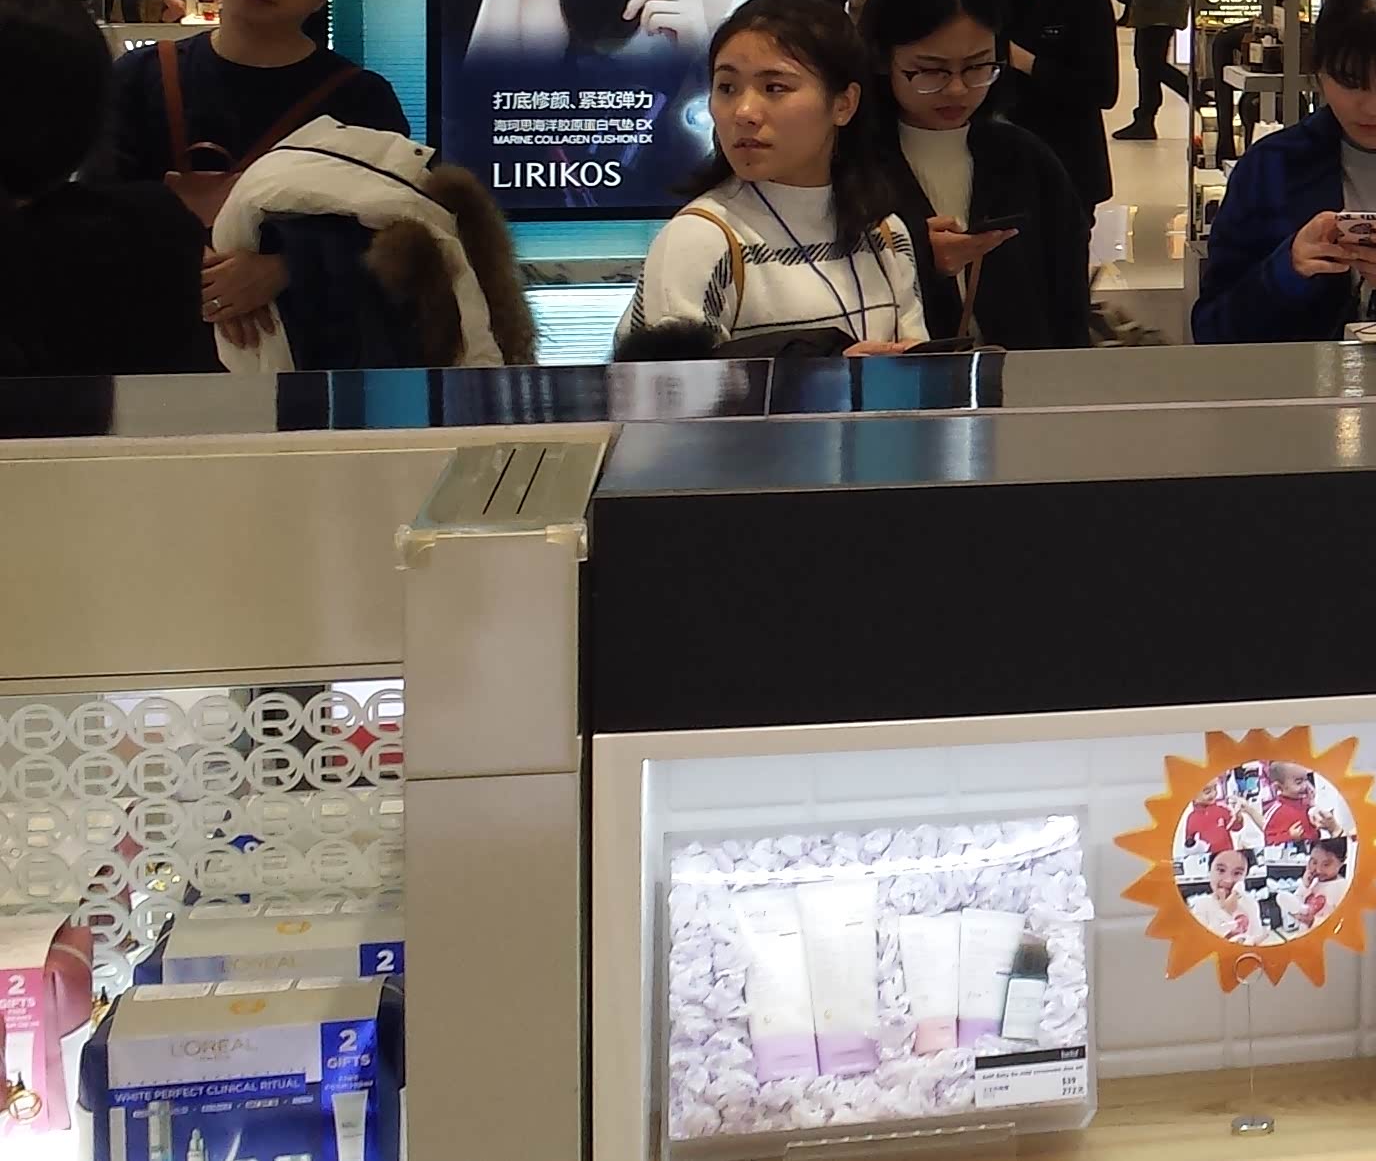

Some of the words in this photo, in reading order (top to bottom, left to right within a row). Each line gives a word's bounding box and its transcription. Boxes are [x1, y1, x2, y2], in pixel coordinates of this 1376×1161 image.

[492, 90, 654, 110] 打底修颜、紧致弹力
[636, 119, 653, 131] EX
[493, 135, 534, 145] MARINE
[534, 134, 590, 145] COLLAGEN
[591, 134, 637, 144] CUSHION
[638, 134, 653, 144] EX
[493, 161, 622, 188] LIRIKOS
[375, 949, 395, 972] 2
[7, 974, 26, 996] 2
[337, 1029, 358, 1052] 2
[327, 1053, 371, 1070] GIFTS
[114, 1090, 152, 1104] WHITE
[153, 1085, 204, 1102] PERFECT
[206, 1081, 258, 1097] CLINICAL
[260, 1077, 301, 1093] RITUAL
